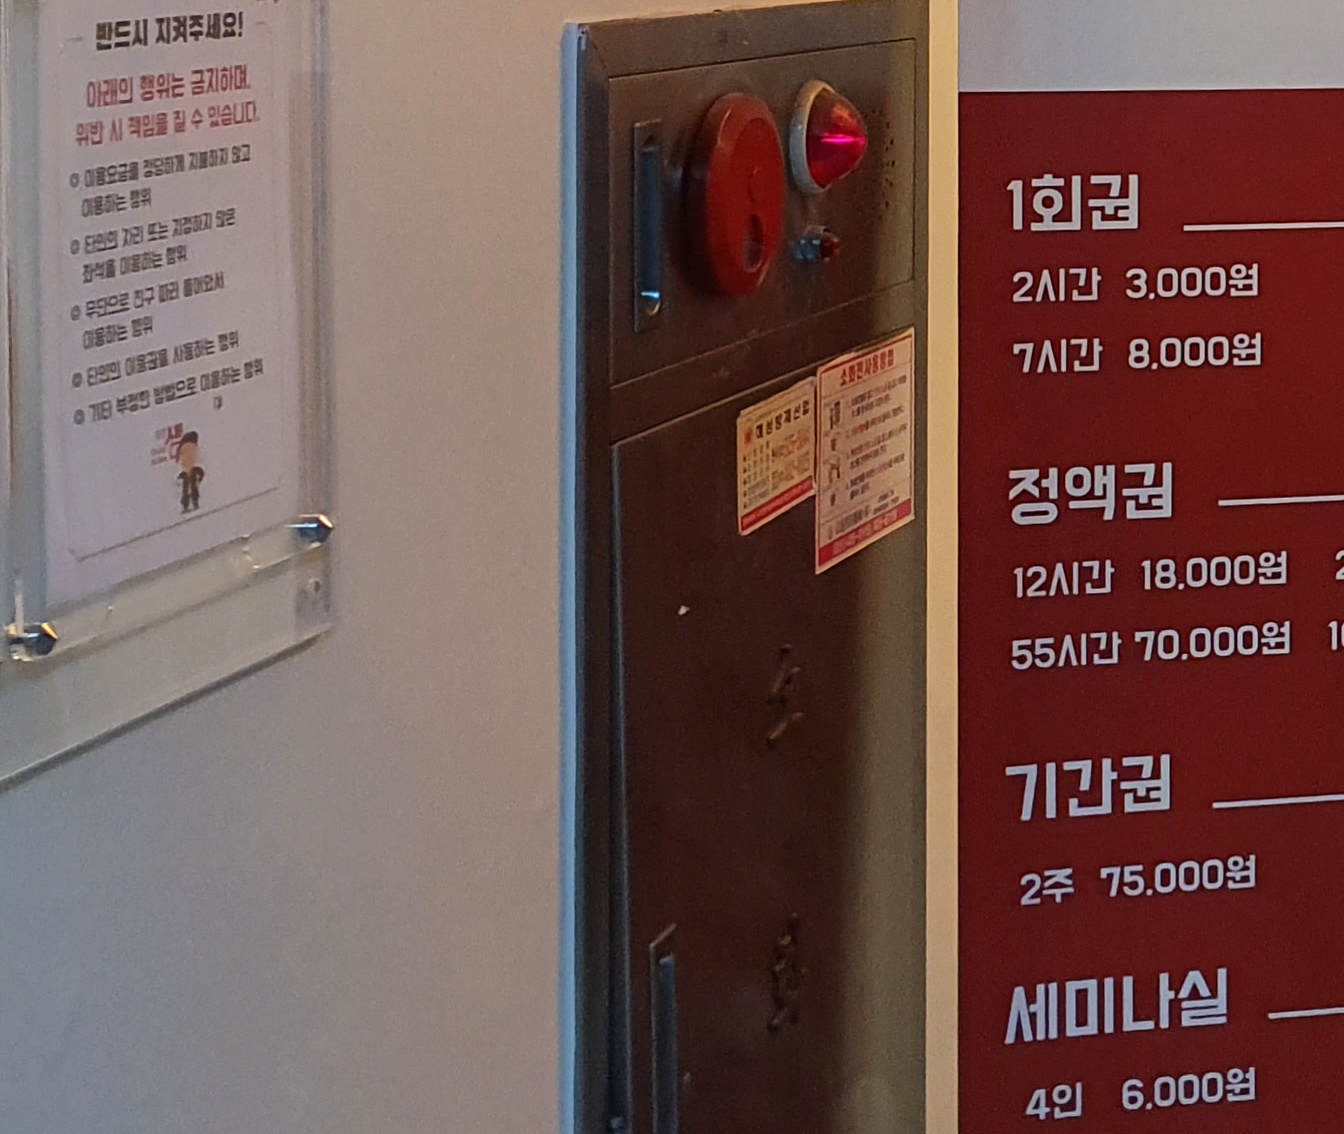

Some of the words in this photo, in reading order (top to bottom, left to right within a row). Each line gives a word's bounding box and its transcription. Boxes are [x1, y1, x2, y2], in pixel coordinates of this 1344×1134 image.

[96, 19, 148, 51] 반드시
[155, 11, 243, 44] 지켜주세요!
[87, 77, 133, 108] 아래의
[140, 73, 185, 101] 행위는
[76, 121, 103, 146] 위반
[110, 118, 122, 141] 시
[128, 113, 167, 138] 책임을
[172, 110, 185, 133] 질
[191, 109, 203, 130] 수
[208, 101, 260, 128] 있습니다.
[84, 162, 139, 187] 이용요금을
[232, 144, 250, 164] 않고
[82, 193, 126, 217] 이용하는
[130, 188, 151, 208] 행위
[1006, 173, 1139, 232] 1회권
[84, 230, 118, 254] 타인의
[122, 226, 143, 247] 자리
[148, 221, 168, 242] 또는
[120, 251, 162, 275] 이용하는
[133, 287, 155, 308] 친구
[1012, 267, 1101, 303] 2시간
[83, 324, 127, 350] 이용하는
[131, 316, 153, 337] 행위
[87, 360, 121, 386] 타인의
[125, 348, 168, 376] 이용권을
[218, 330, 239, 352] 행위
[1012, 337, 1103, 374] 7시간
[89, 400, 112, 422] 기타
[1008, 461, 1173, 526] 정액권
[1013, 559, 1114, 598] 12시간
[1010, 631, 1122, 671] 55시간
[1005, 753, 1171, 821] 기간권
[1019, 867, 1075, 906] 2주
[1003, 967, 1228, 1046] 세미나실
[1025, 1081, 1083, 1121] 4인
